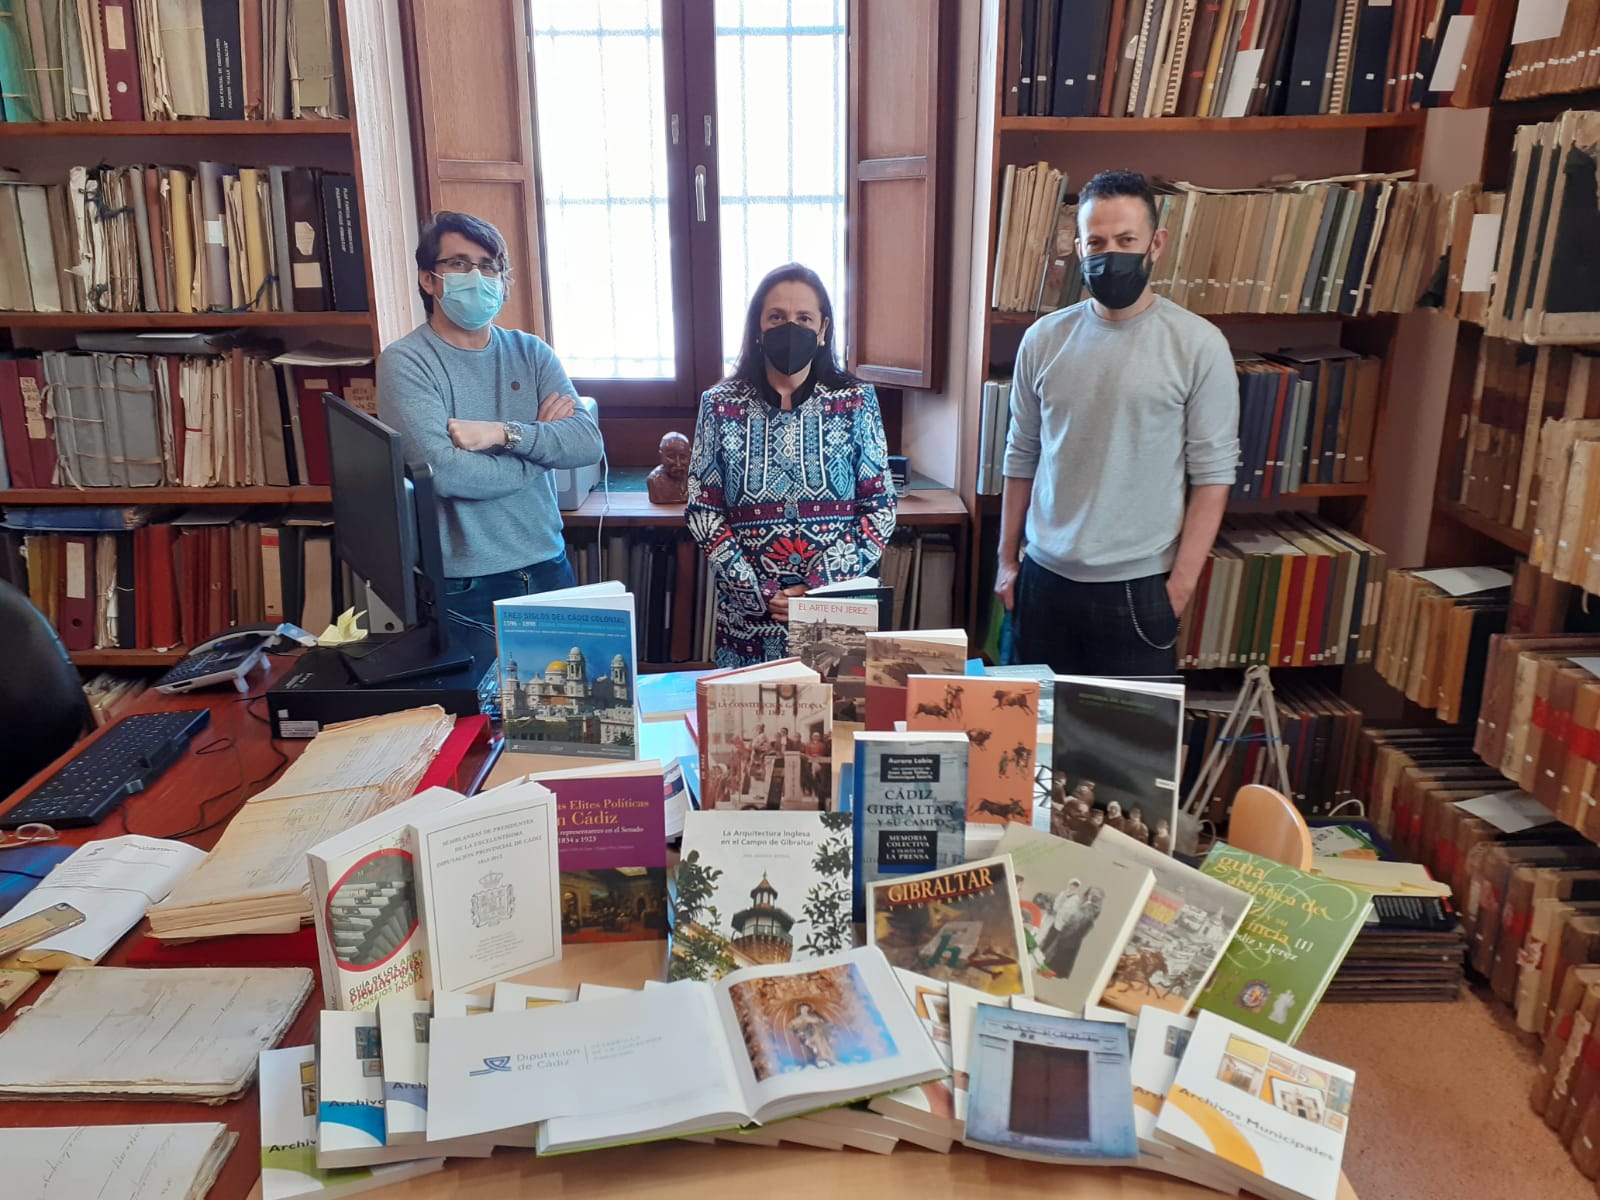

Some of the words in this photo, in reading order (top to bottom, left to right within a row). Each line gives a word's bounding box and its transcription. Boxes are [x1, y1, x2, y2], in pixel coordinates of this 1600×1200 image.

[809, 604, 828, 612] ARTE
[831, 605, 842, 613] EN
[846, 606, 868, 614] JEREZ
[524, 612, 549, 620] SIGLOS
[591, 615, 624, 624] COLONIAL
[885, 788, 937, 802] CÁDIZ,
[603, 798, 650, 808] Políticas
[867, 804, 953, 815] GIBRALTAR
[558, 816, 566, 826] n
[572, 810, 618, 825] Cádiz
[493, 819, 534, 832] PRESIDENTES
[733, 830, 781, 838] Arquitectura
[784, 830, 810, 838] Inglesa
[476, 842, 512, 856] PROVINCIAL
[888, 867, 993, 902] GIBRALTAR
[1246, 922, 1289, 944] incia
[1266, 943, 1299, 960] Jerez
[383, 964, 398, 976] LOS
[517, 1048, 580, 1062] Diputación
[518, 1063, 532, 1071] de
[537, 1059, 568, 1069] Cádiz
[1133, 1086, 1164, 1101] Arch
[328, 1098, 384, 1107] Archivo
[1178, 1087, 1242, 1120] Archivos
[1246, 1118, 1334, 1161] Municipales
[268, 1140, 316, 1154] Archiv
